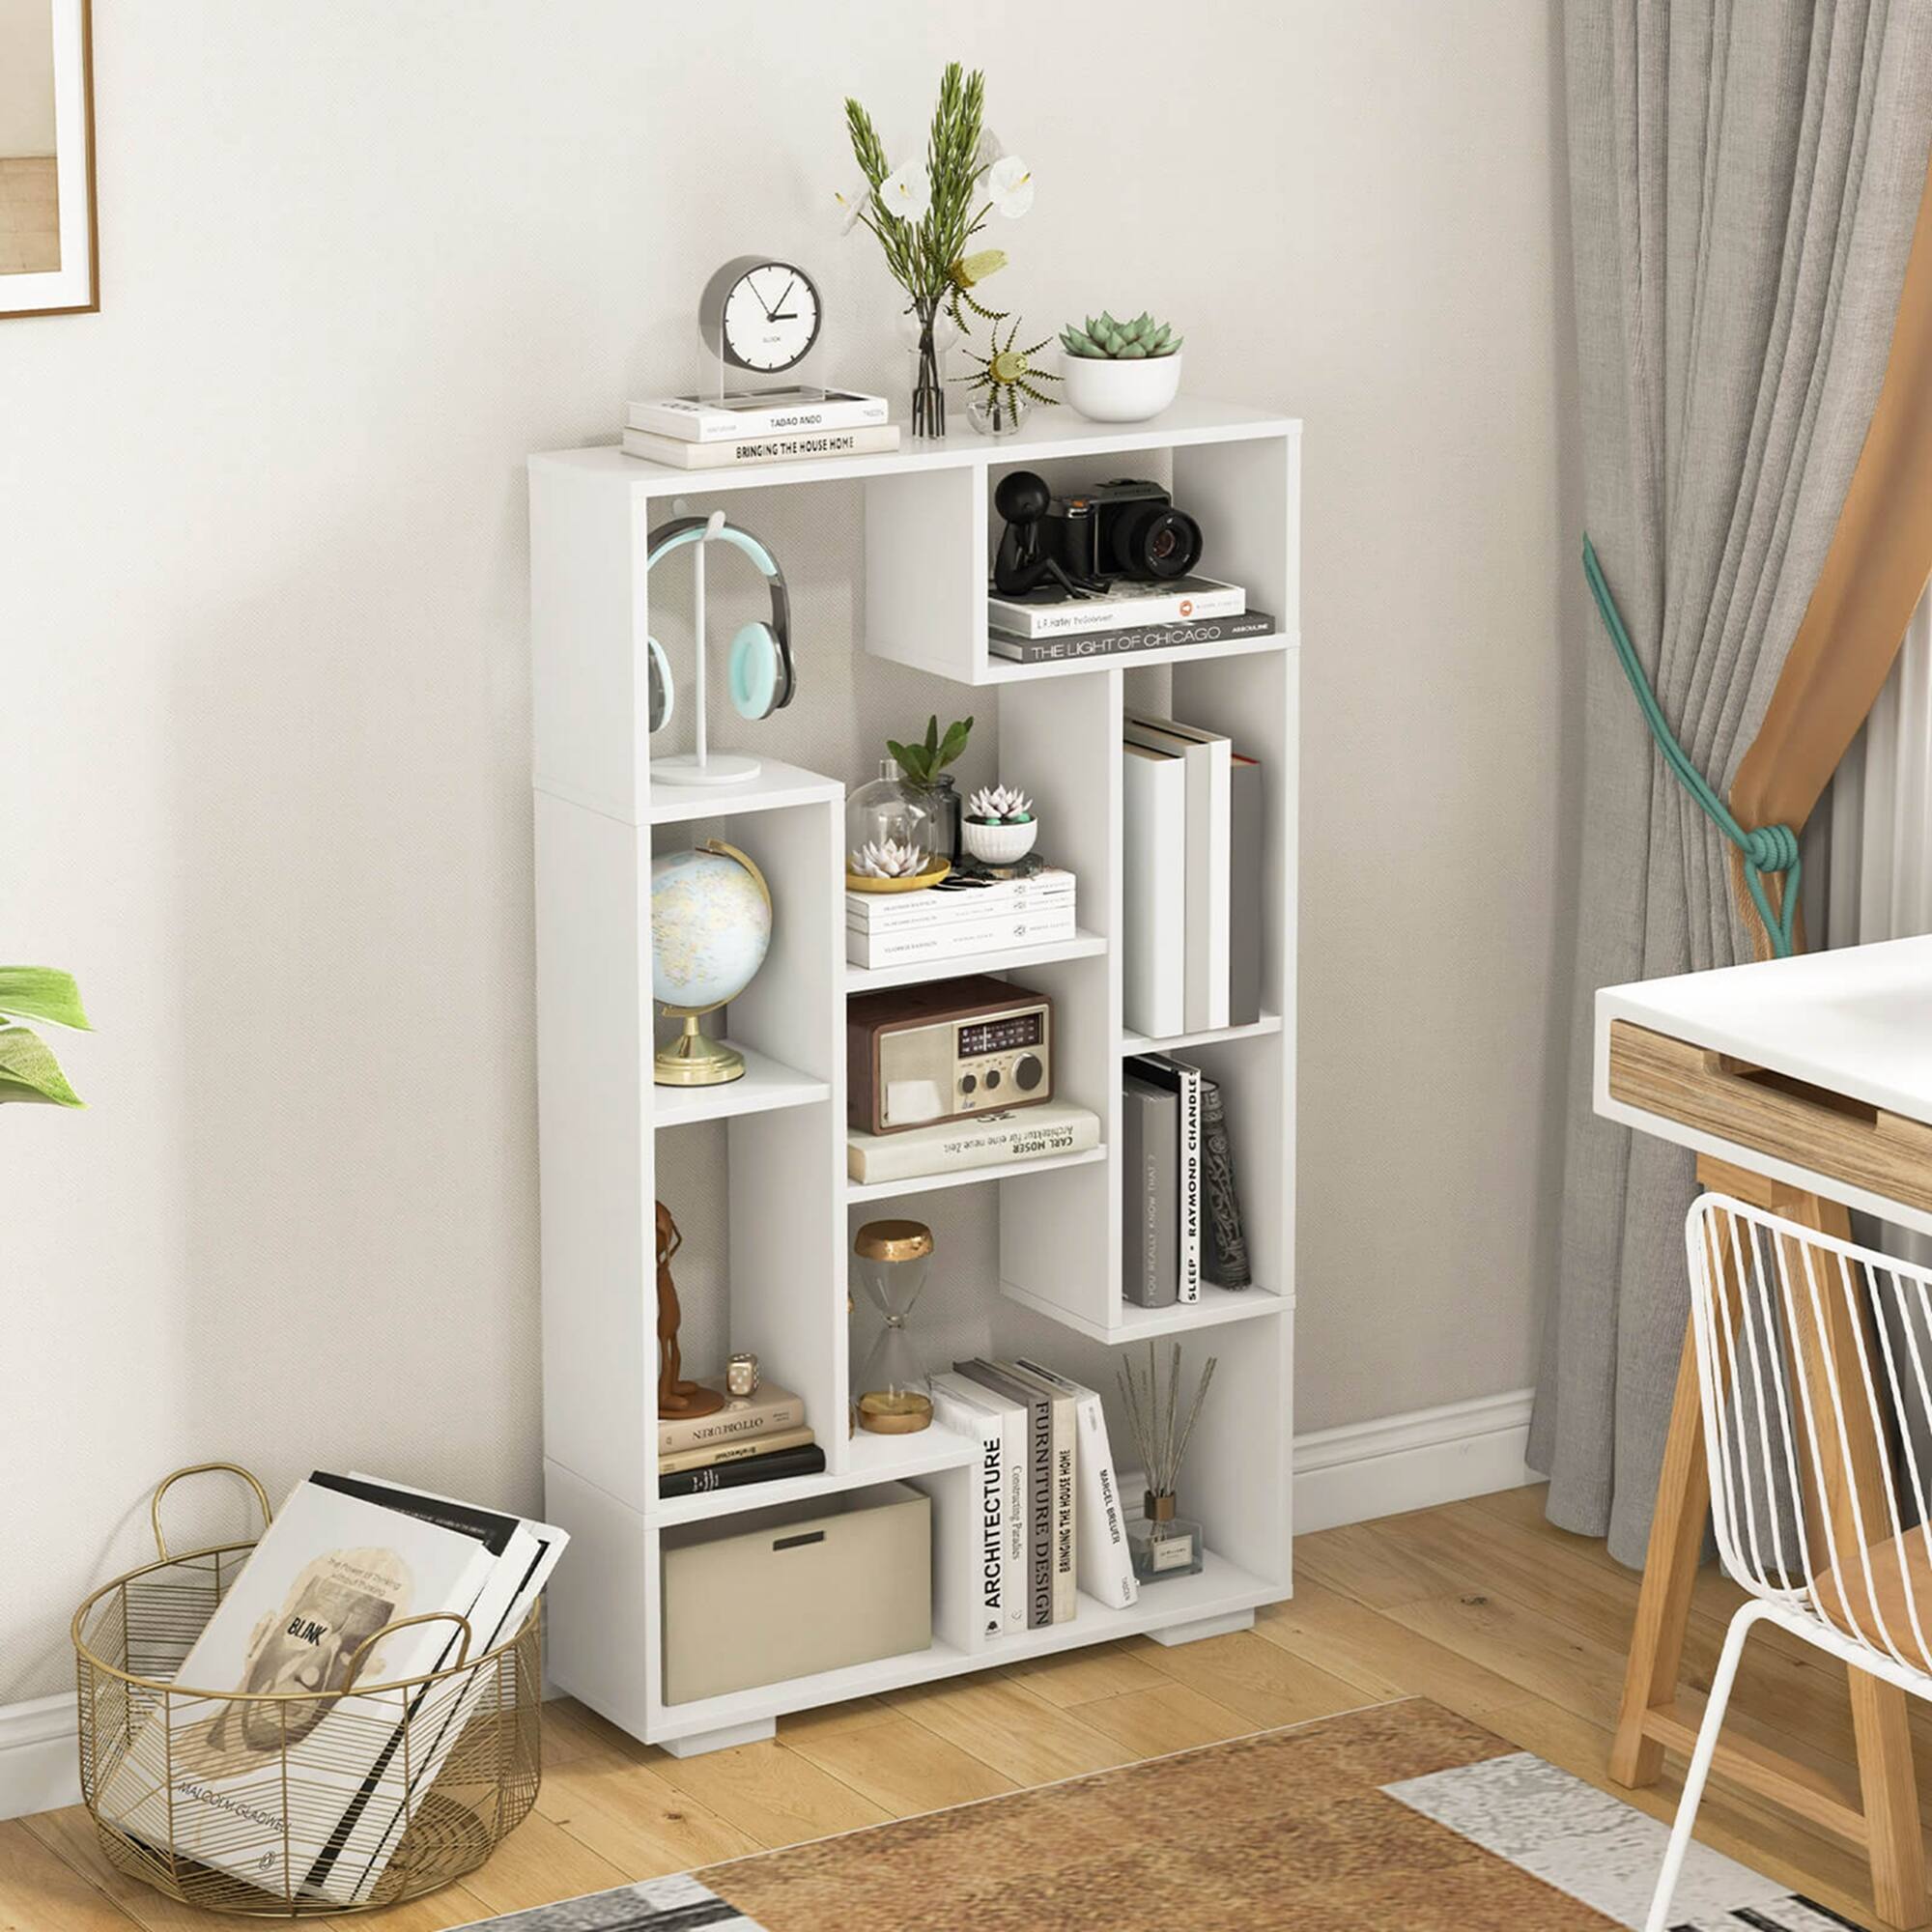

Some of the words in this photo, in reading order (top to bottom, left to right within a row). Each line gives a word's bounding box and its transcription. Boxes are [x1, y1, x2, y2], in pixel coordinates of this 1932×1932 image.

[770, 417, 798, 428] TADAO
[799, 414, 822, 425] ANDO
[736, 443, 779, 459] BRINGING
[781, 441, 797, 455] THE
[799, 439, 828, 453] HOUSE
[829, 437, 854, 450] HOME
[1032, 643, 1065, 660] THE
[1067, 639, 1115, 657] LIGHT
[1117, 635, 1142, 650] OF
[1144, 626, 1221, 647] CHICAGO
[1012, 1141, 1046, 1153] MOSER
[1050, 1136, 1073, 1148] CARL
[1188, 1157, 1197, 1237] RAYMOND
[1188, 1259, 1197, 1301] SLEEP
[692, 1417, 764, 1440] OTTOBEUREN
[1035, 1401, 1050, 1536] FURNITURE
[1059, 1450, 1071, 1476] HOME
[1009, 1464, 1022, 1521] Constructing
[1059, 1478, 1071, 1508] HOUSE
[1099, 1468, 1112, 1506] MARCEL
[1106, 1507, 1121, 1545] BREUER
[983, 1437, 1001, 1608] ARCHITECTURE
[1059, 1509, 1071, 1528] THE
[1059, 1529, 1071, 1574] BRINGING
[1035, 1543, 1050, 1626] DESIGN
[287, 1617, 328, 1646] BLINK
[178, 1781, 236, 1811] MALCOLM
